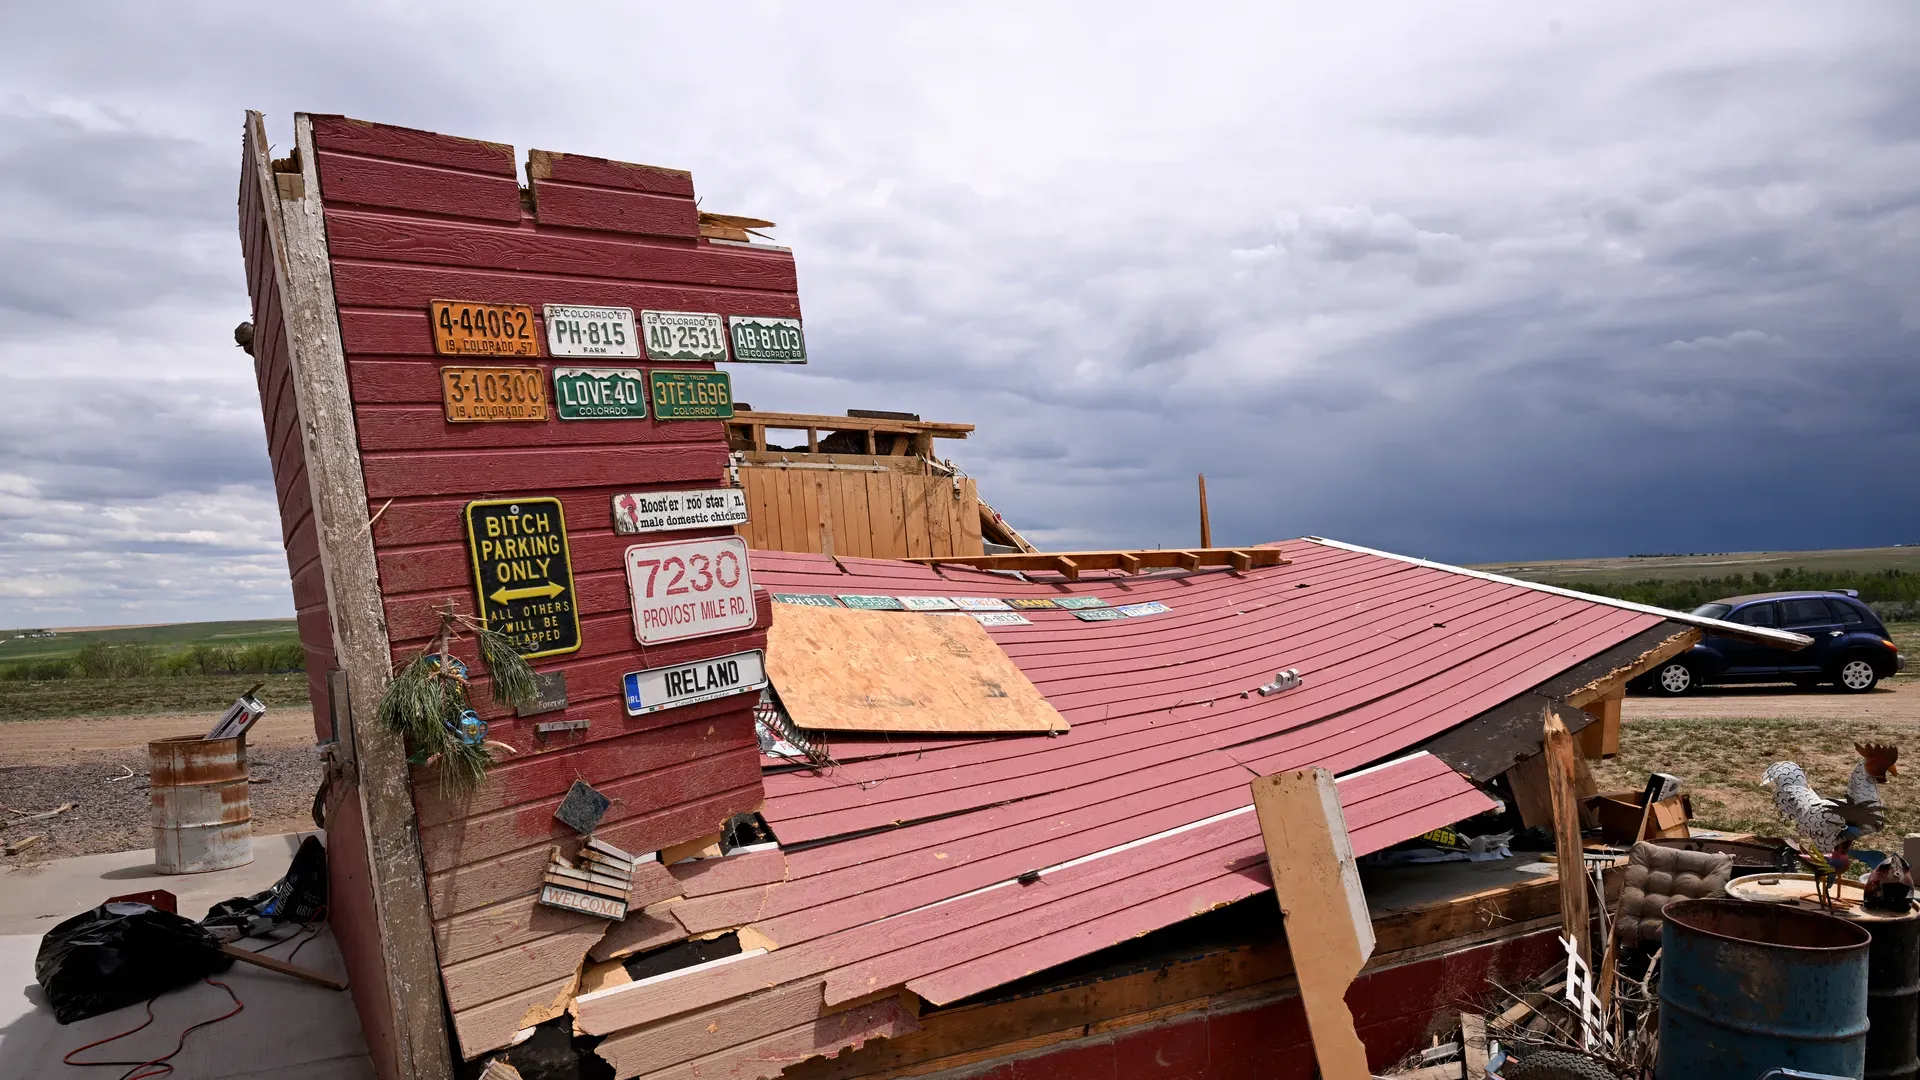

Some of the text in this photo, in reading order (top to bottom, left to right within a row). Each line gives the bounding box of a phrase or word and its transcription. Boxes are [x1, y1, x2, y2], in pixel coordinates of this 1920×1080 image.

[563, 309, 615, 319] COLORADO
[616, 312, 628, 320] 67
[659, 317, 706, 326] COLORADO
[445, 339, 533, 353] 19 COLORADO 57
[750, 350, 791, 358] COLORADO
[655, 381, 729, 405] 3TE1696
[455, 405, 542, 417] 19 COLORADO 57
[579, 406, 628, 416] COLORADO
[672, 407, 717, 416] COLORADO
[733, 495, 744, 506] n.
[485, 513, 550, 538] BITCH
[640, 511, 747, 528] male domestic chicken
[481, 535, 560, 561] PARKING
[496, 557, 551, 583] ONLY
[637, 550, 741, 599] 7230
[491, 600, 570, 622] ALL OTHERS
[643, 596, 748, 629] PROVOST MILE RD.
[505, 615, 559, 634] WILL BE
[664, 660, 740, 698] IRELAND
[538, 698, 566, 709] Forever
[627, 694, 640, 705] IRL
[548, 887, 623, 917] WELCOME
